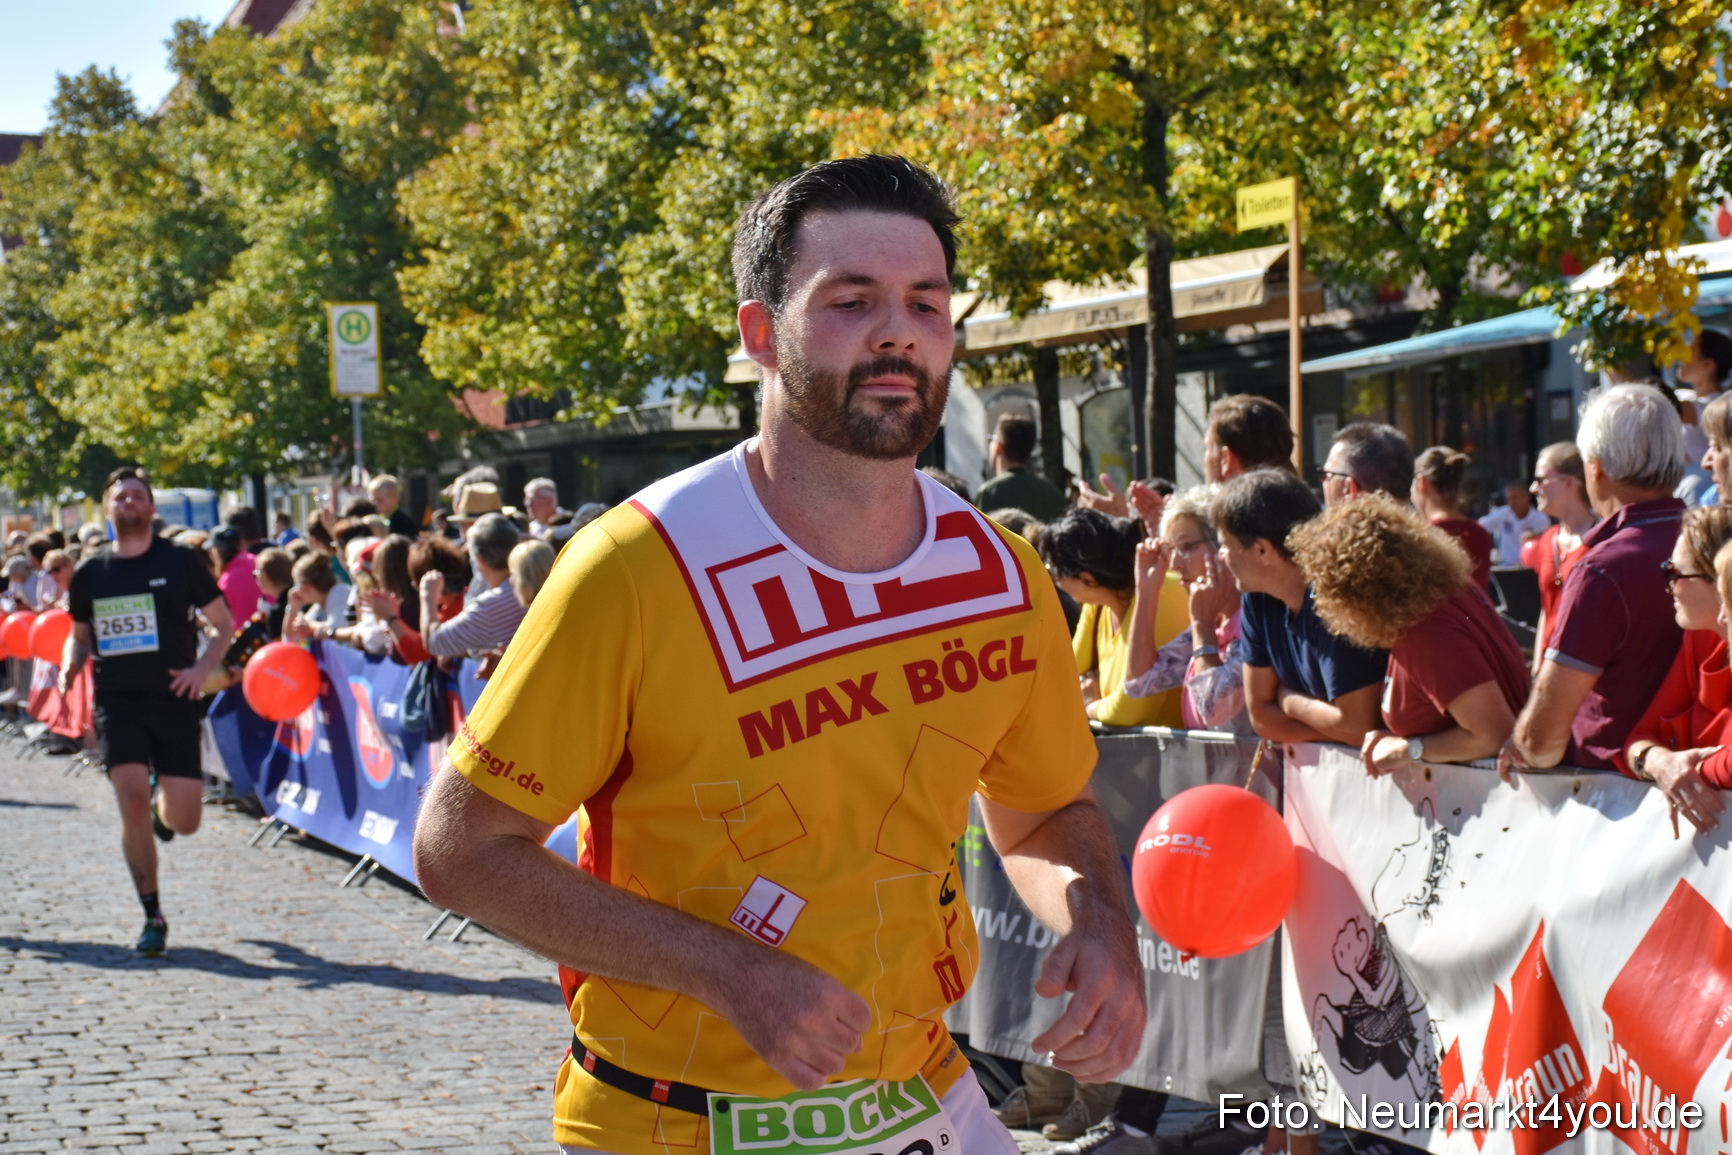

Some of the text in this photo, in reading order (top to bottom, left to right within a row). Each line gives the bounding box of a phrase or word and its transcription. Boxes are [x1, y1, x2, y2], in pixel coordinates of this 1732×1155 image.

[101, 616, 147, 636] 2653
[737, 635, 1037, 759] MAX BÖGL
[462, 723, 544, 796] ax-boegl.de
[737, 1080, 916, 1143] BOCK
[1504, 1043, 1584, 1131] Braun
[1600, 1008, 1683, 1155] Braun
[940, 1134, 949, 1146] D
